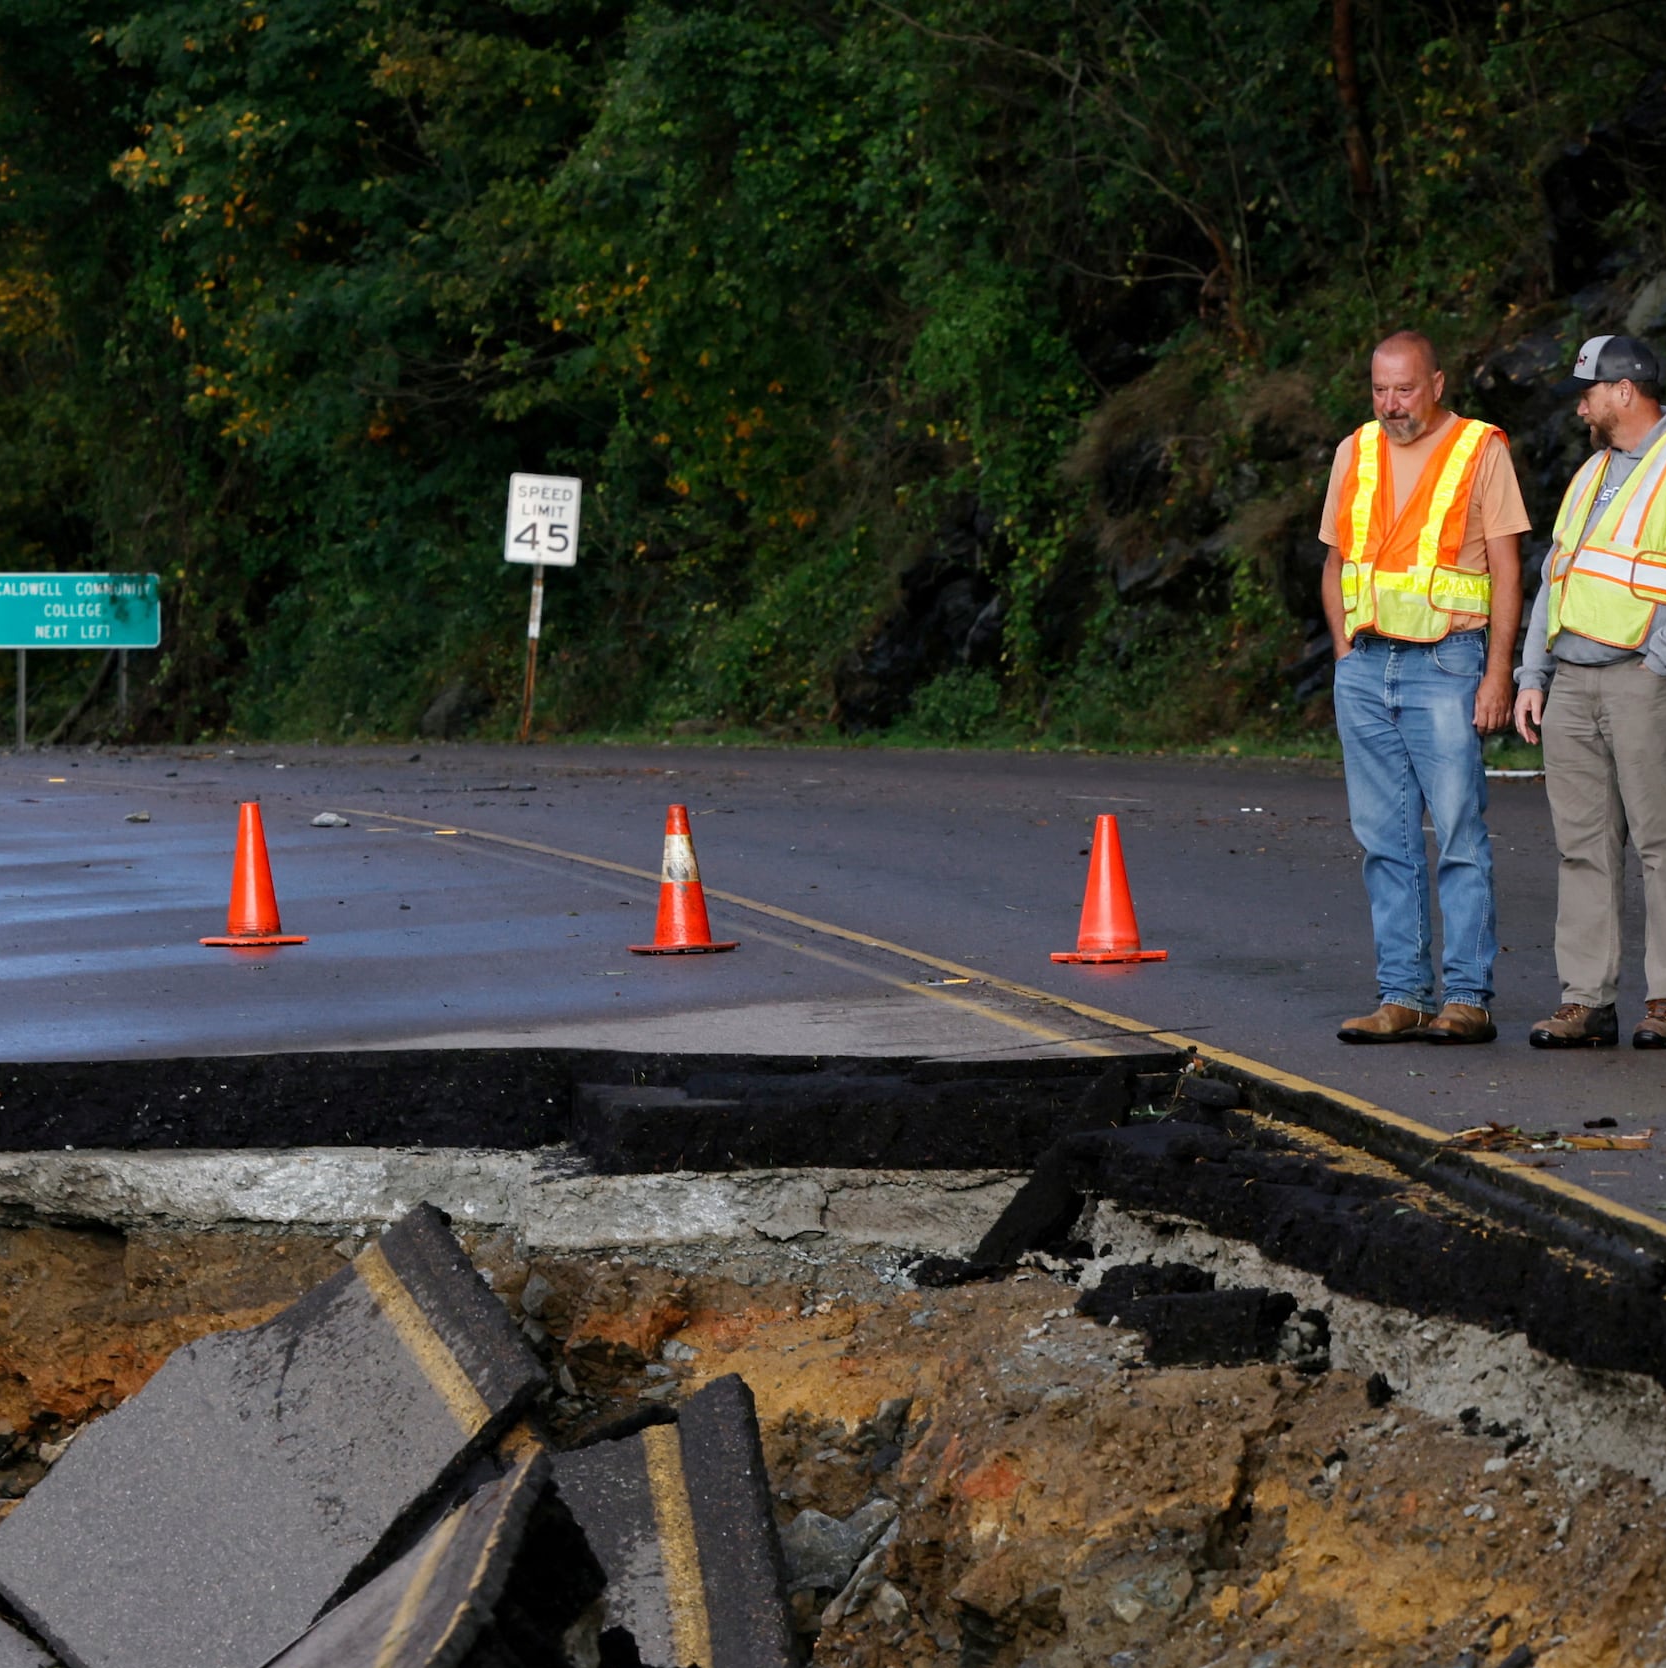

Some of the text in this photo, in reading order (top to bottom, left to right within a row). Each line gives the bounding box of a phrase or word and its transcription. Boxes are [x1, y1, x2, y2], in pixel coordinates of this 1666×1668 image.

[518, 486, 573, 502] SPEED
[522, 504, 565, 519] LIMIT
[514, 522, 569, 553] 45
[44, 603, 102, 617] COLLEGE
[35, 624, 110, 639] NEXT LEFT
